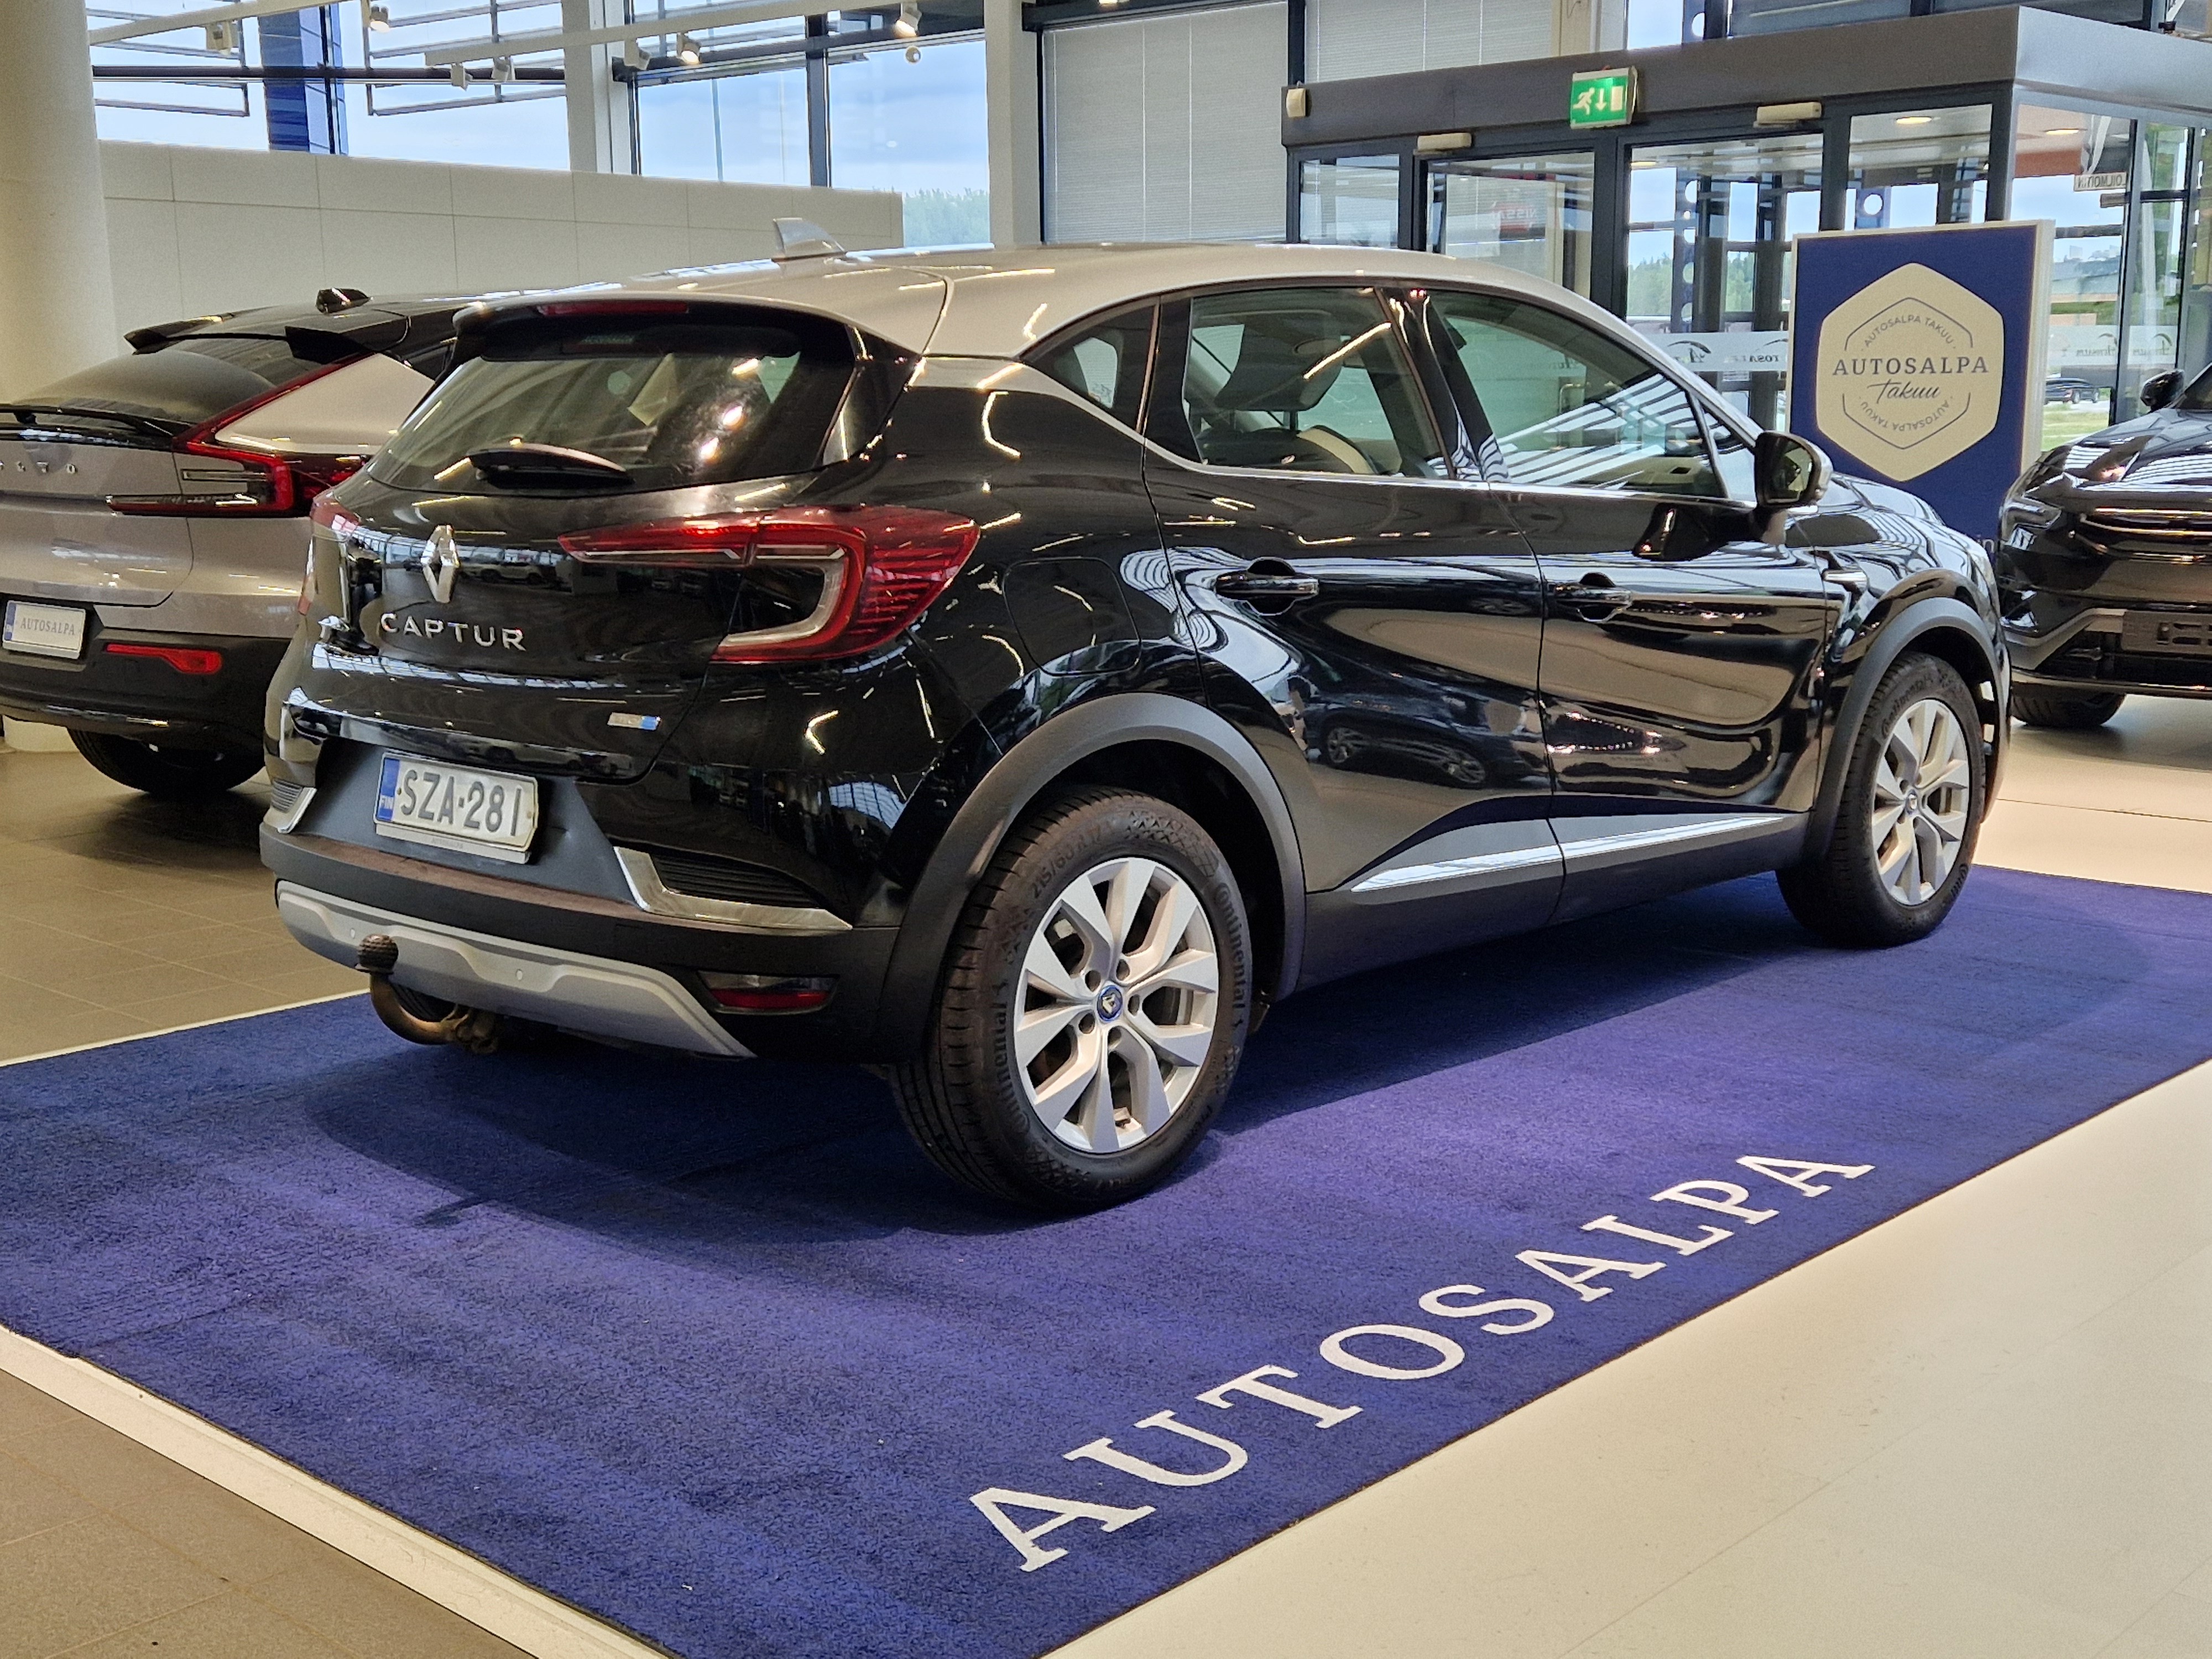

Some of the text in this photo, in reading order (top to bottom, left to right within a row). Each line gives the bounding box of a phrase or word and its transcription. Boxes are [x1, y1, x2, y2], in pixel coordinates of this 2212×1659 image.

[1864, 314, 1955, 347] AUTOSALPA TAKUU
[1832, 357, 1989, 376] AUTOSALPA
[1860, 400, 1950, 432] AUTOSALPA TAKUU
[20, 618, 75, 635] AUTOSALPA
[380, 613, 526, 651] CAPTUR
[969, 1155, 1874, 1572] AUTOSALPA
